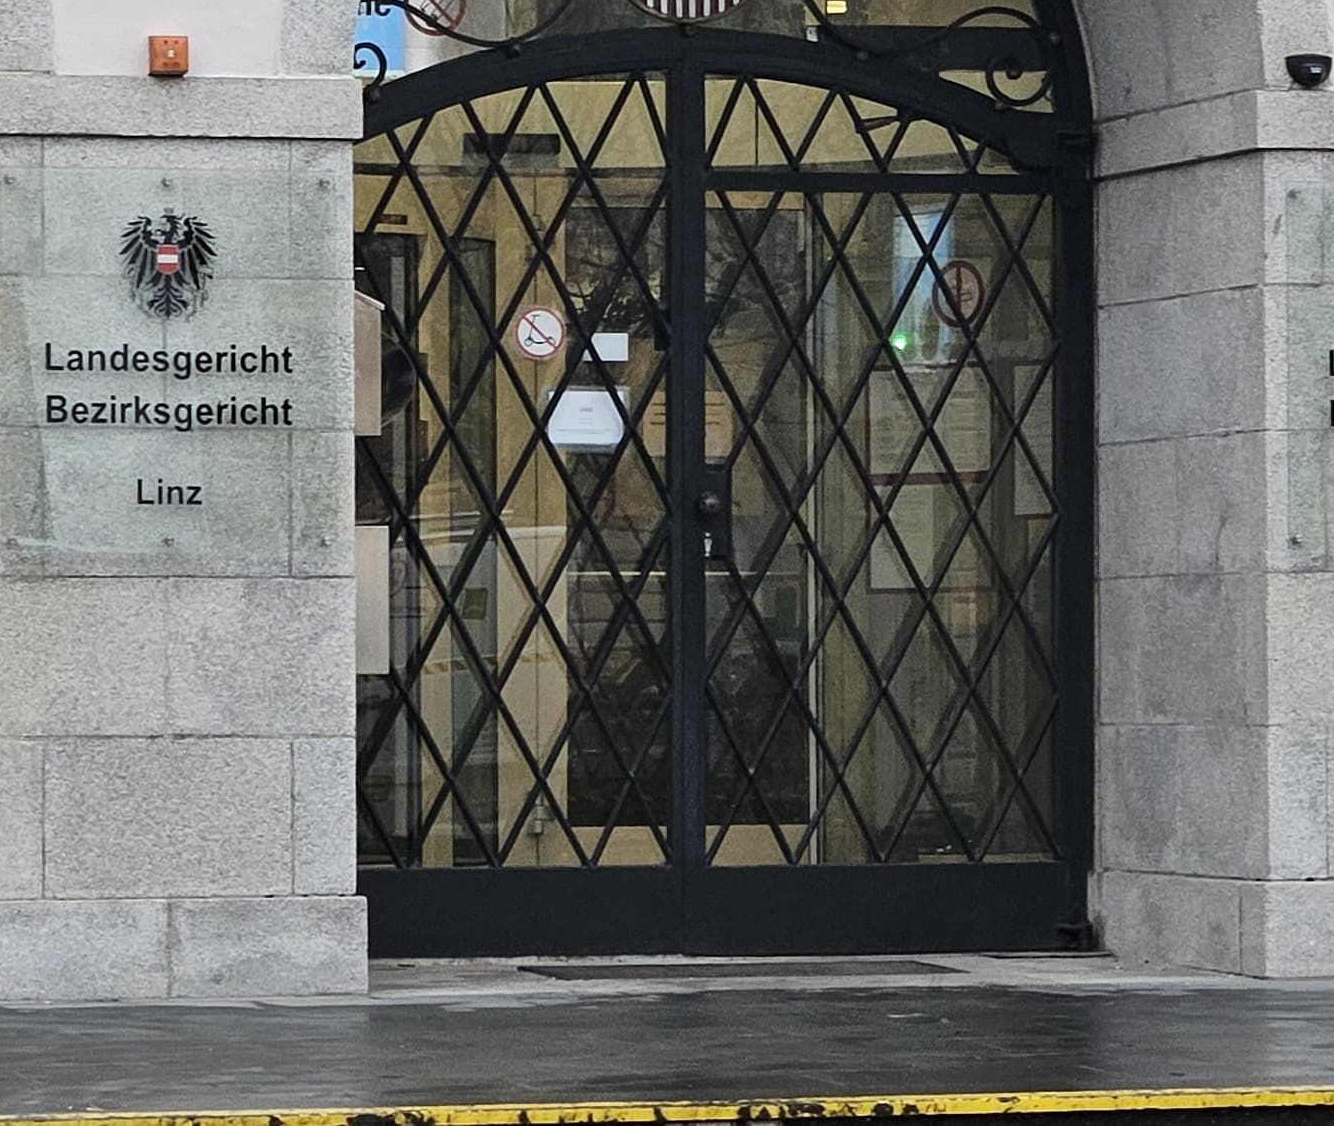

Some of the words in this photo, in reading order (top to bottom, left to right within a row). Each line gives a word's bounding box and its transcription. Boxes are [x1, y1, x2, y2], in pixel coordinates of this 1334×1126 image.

[44, 342, 293, 380] Landesgericht
[45, 394, 293, 432] Bezirksgericht
[136, 478, 203, 506] Linz
